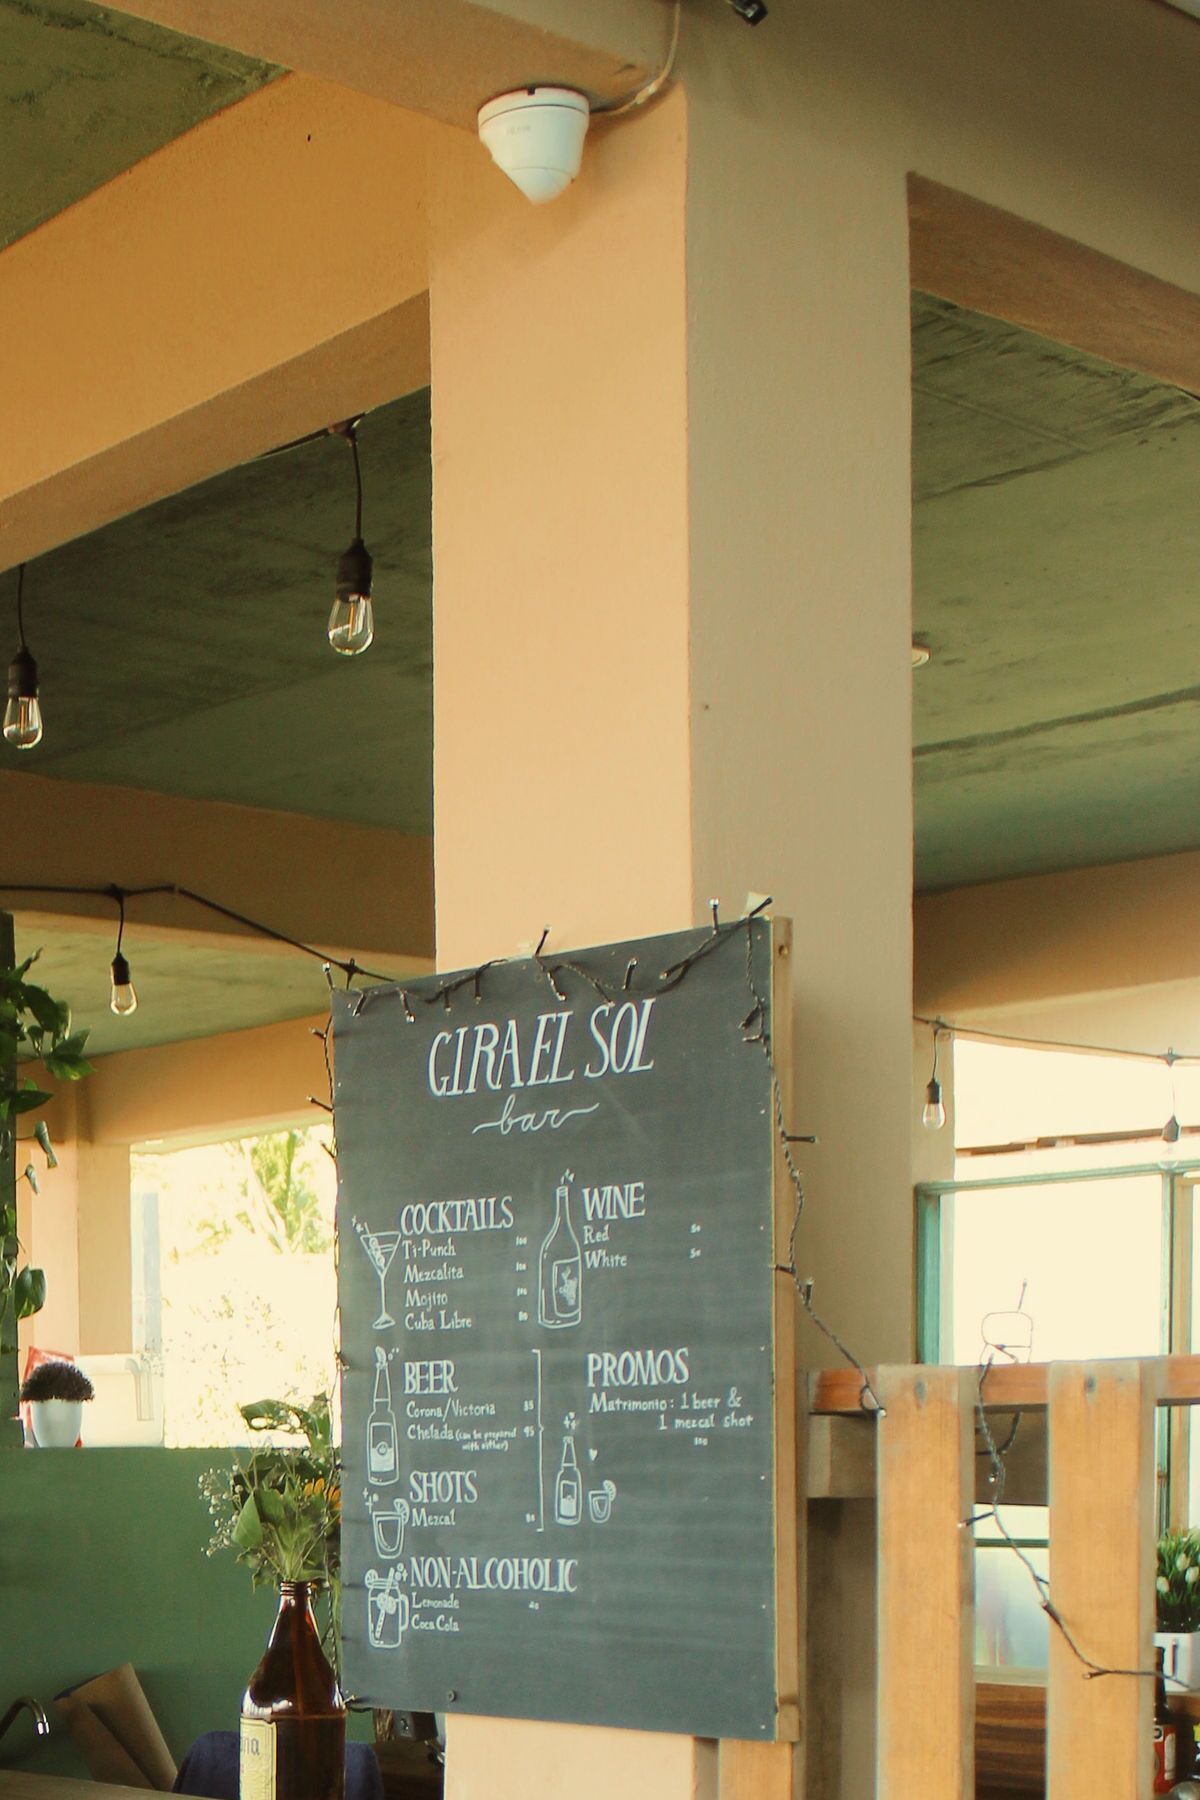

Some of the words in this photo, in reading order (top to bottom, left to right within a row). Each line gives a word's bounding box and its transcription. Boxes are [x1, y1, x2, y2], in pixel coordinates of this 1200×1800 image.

[584, 998, 656, 1077] SOL
[582, 1182, 645, 1221] WINE
[400, 1196, 514, 1236] COCKTAILS
[583, 1224, 609, 1244] Red
[402, 1237, 456, 1259] Ti-Punch
[584, 1249, 627, 1268] White
[404, 1262, 463, 1283] Mezcalita
[405, 1289, 447, 1312] Mojito
[405, 1312, 434, 1330] Cuba
[440, 1310, 471, 1329] Libre
[404, 1360, 458, 1394] BEER
[588, 1348, 689, 1387] PROMOS
[692, 1393, 720, 1409] beer
[728, 1387, 742, 1407] &
[407, 1398, 495, 1422] Corona/Victoria
[659, 1414, 667, 1430] 1
[675, 1414, 714, 1429] mezcal
[723, 1411, 753, 1427] shot
[407, 1424, 454, 1440] Chelada
[410, 1471, 477, 1503] SHOTS
[412, 1508, 455, 1526] Mezcal
[410, 1556, 578, 1593] NON-ALCOHOLIC
[412, 1592, 459, 1608] Lemonade
[411, 1613, 435, 1630] Coca
[436, 1615, 459, 1631] Cola
